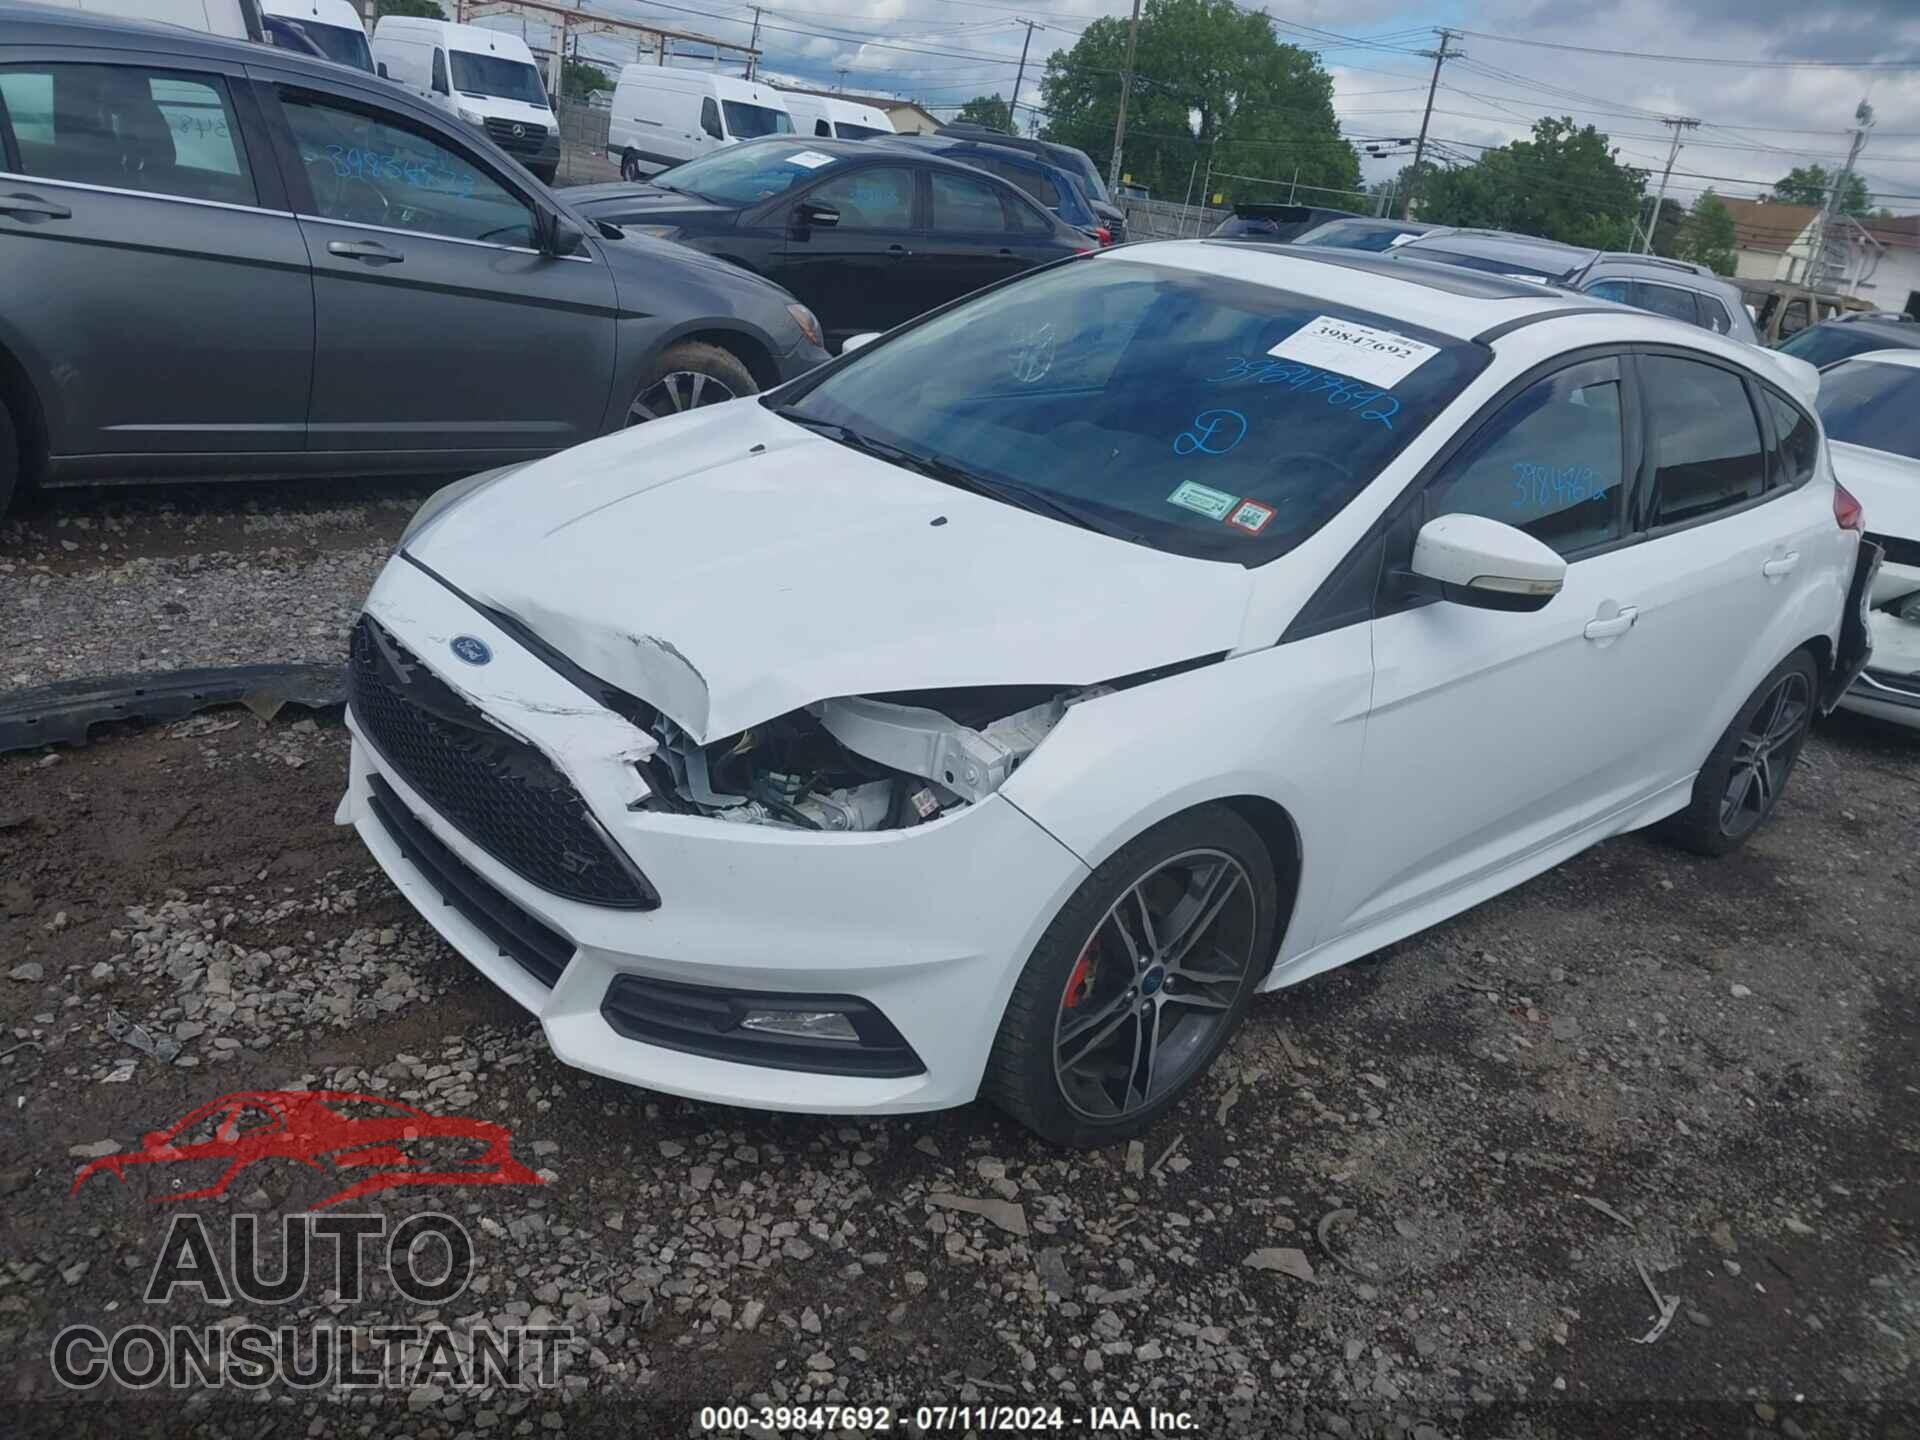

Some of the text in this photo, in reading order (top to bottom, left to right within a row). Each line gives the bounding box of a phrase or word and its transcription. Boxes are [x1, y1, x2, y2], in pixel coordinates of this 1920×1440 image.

[1311, 326, 1412, 359] 39847692
[1206, 356, 1400, 430] 39847692
[1173, 409, 1248, 455] D
[560, 849, 596, 874] ST
